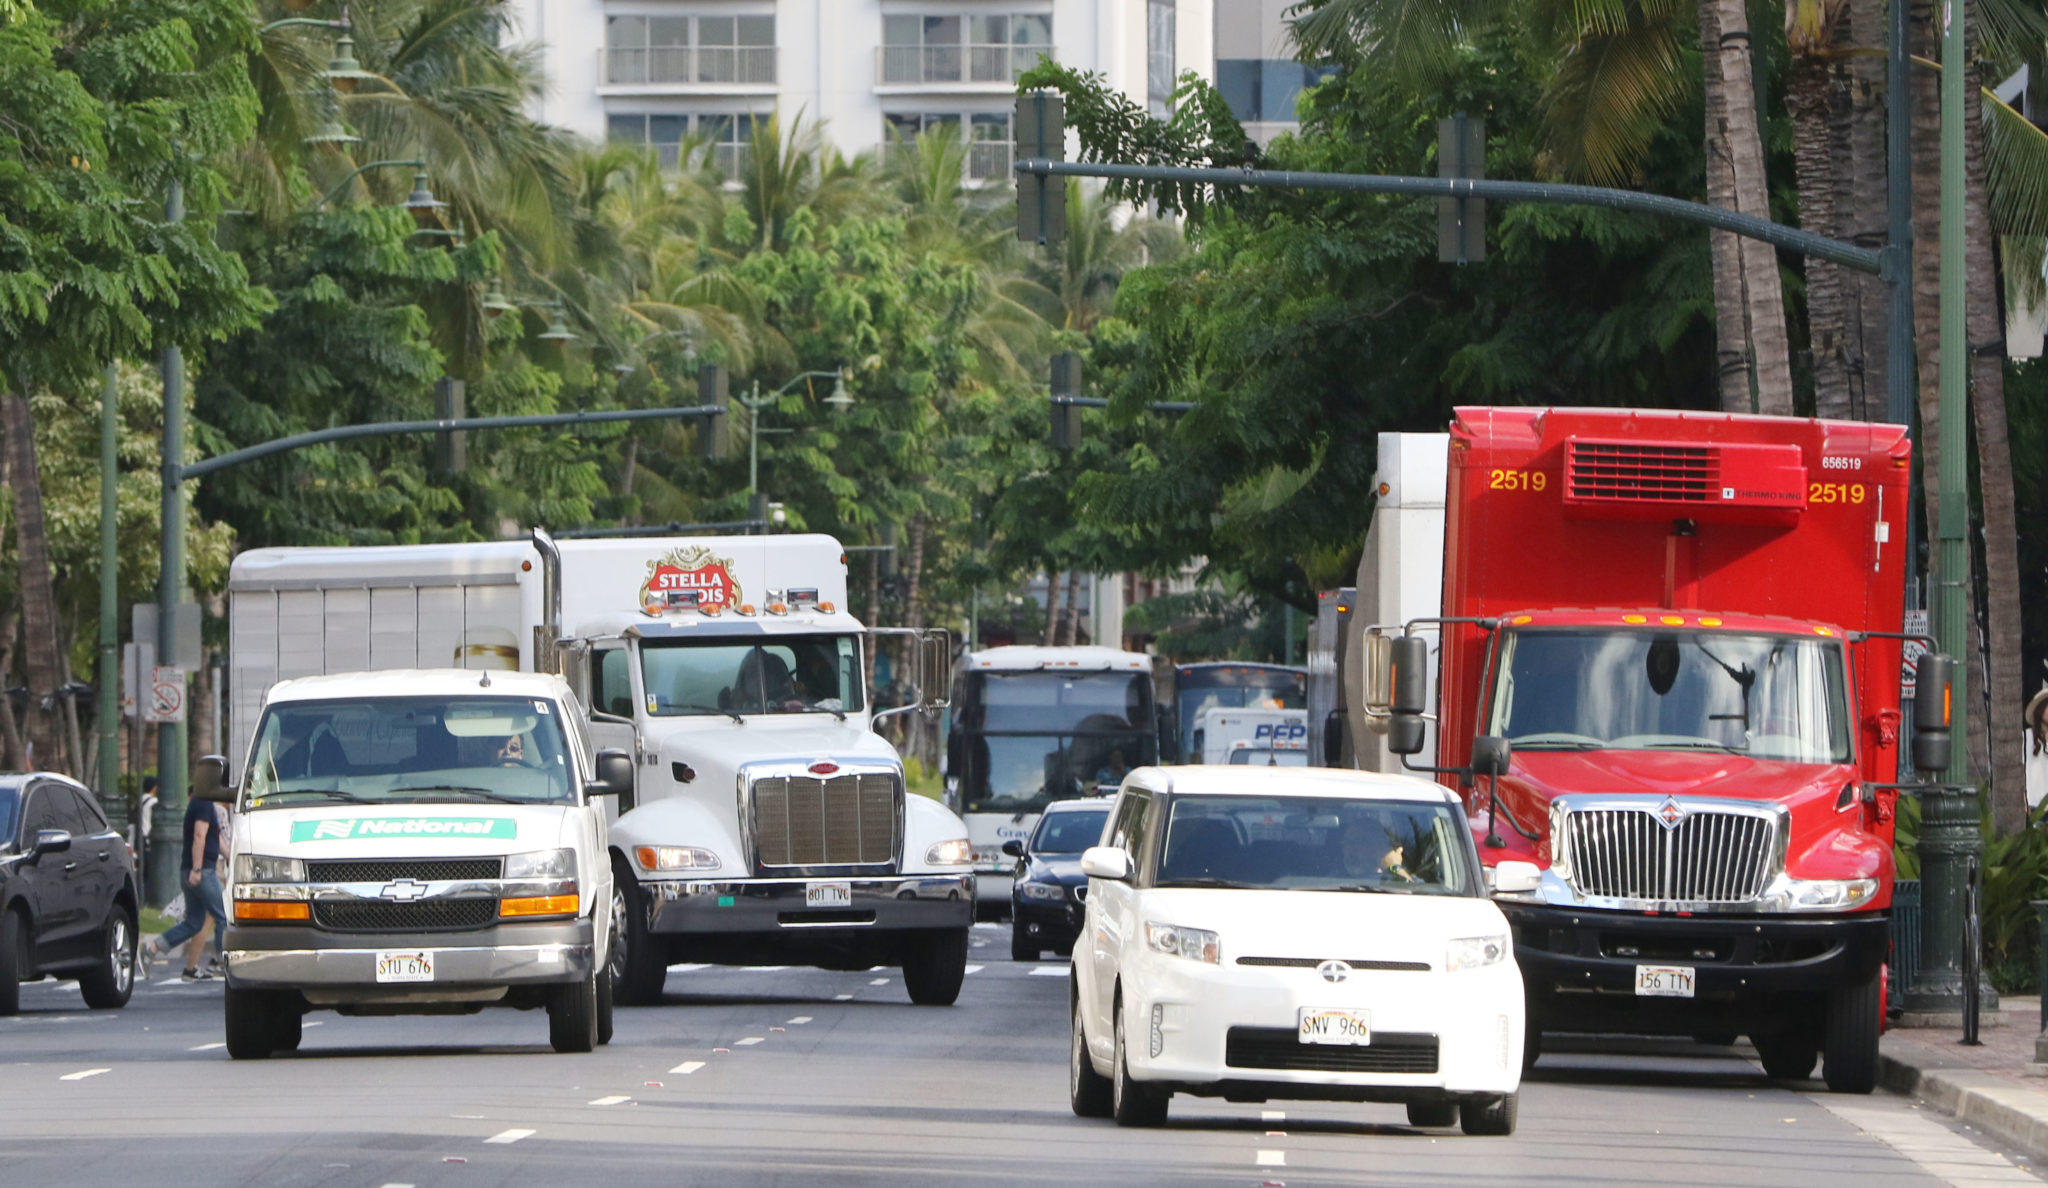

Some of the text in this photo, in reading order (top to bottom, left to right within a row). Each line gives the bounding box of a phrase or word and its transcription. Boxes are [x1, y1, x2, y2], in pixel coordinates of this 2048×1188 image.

[1822, 457, 1861, 470] 656519
[1490, 469, 1547, 492] 2519
[1809, 483, 1865, 504] 2519
[659, 573, 724, 588] STELLA
[358, 819, 495, 835] National
[379, 959, 431, 975] STU 676
[1640, 972, 1692, 990] 156 TTY
[1303, 1016, 1367, 1037] SNV 966
